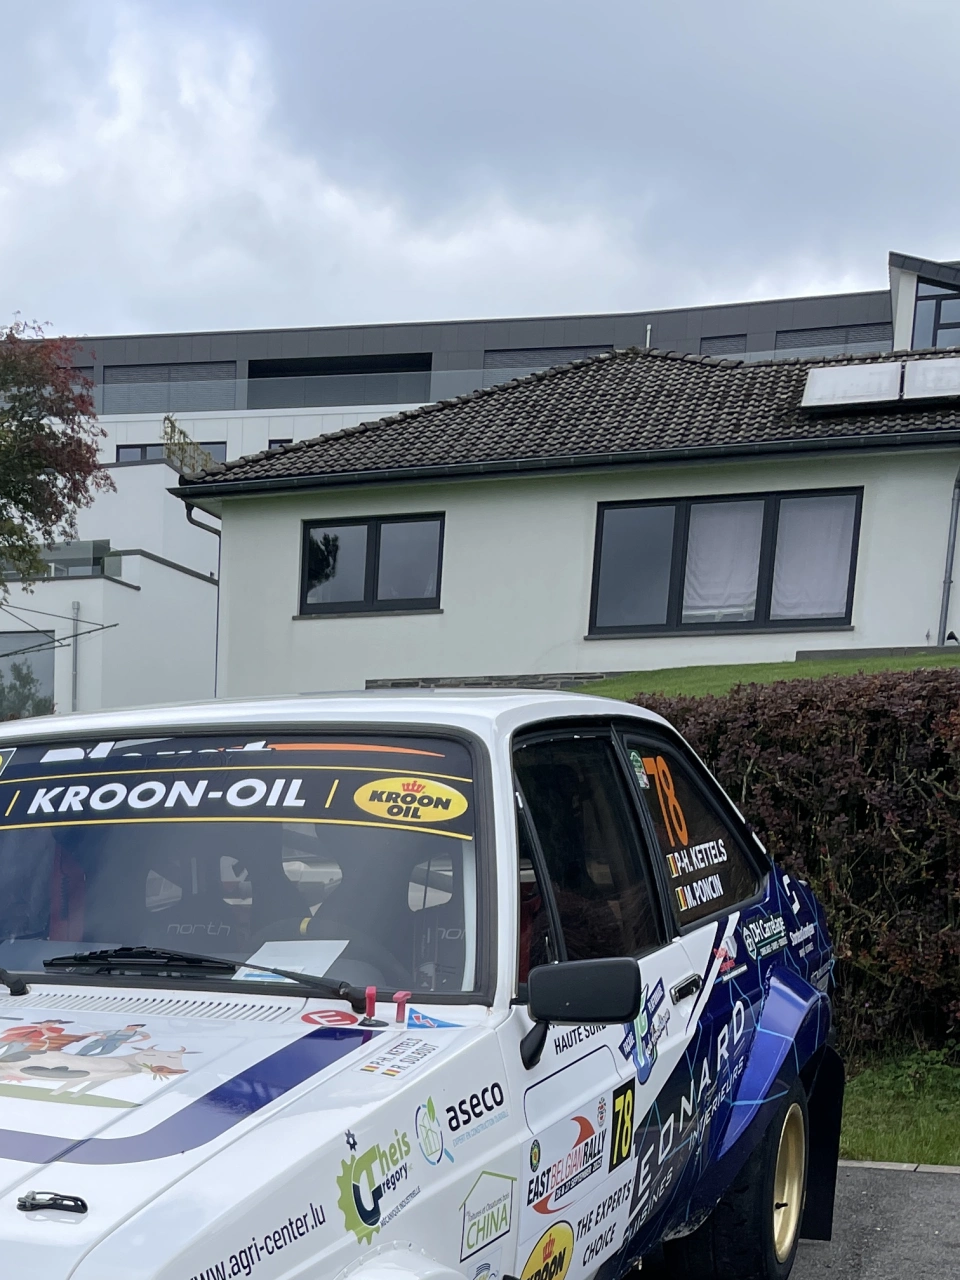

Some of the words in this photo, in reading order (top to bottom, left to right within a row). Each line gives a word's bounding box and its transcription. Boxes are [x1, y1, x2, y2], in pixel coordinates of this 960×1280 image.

[27, 778, 306, 814] KROON-OIL
[368, 790, 452, 811] KROON
[387, 804, 422, 820] OIL
[642, 756, 688, 847] 78
[690, 838, 727, 870] KETTELS
[692, 873, 724, 905] PONCIN
[167, 921, 231, 937] north
[553, 1026, 584, 1055] HAUTE
[446, 1082, 505, 1132] aseco
[612, 1089, 633, 1165] 78
[466, 1203, 508, 1249] CHINA
[576, 1209, 594, 1242] THE
[582, 1222, 617, 1267] CHOICE
